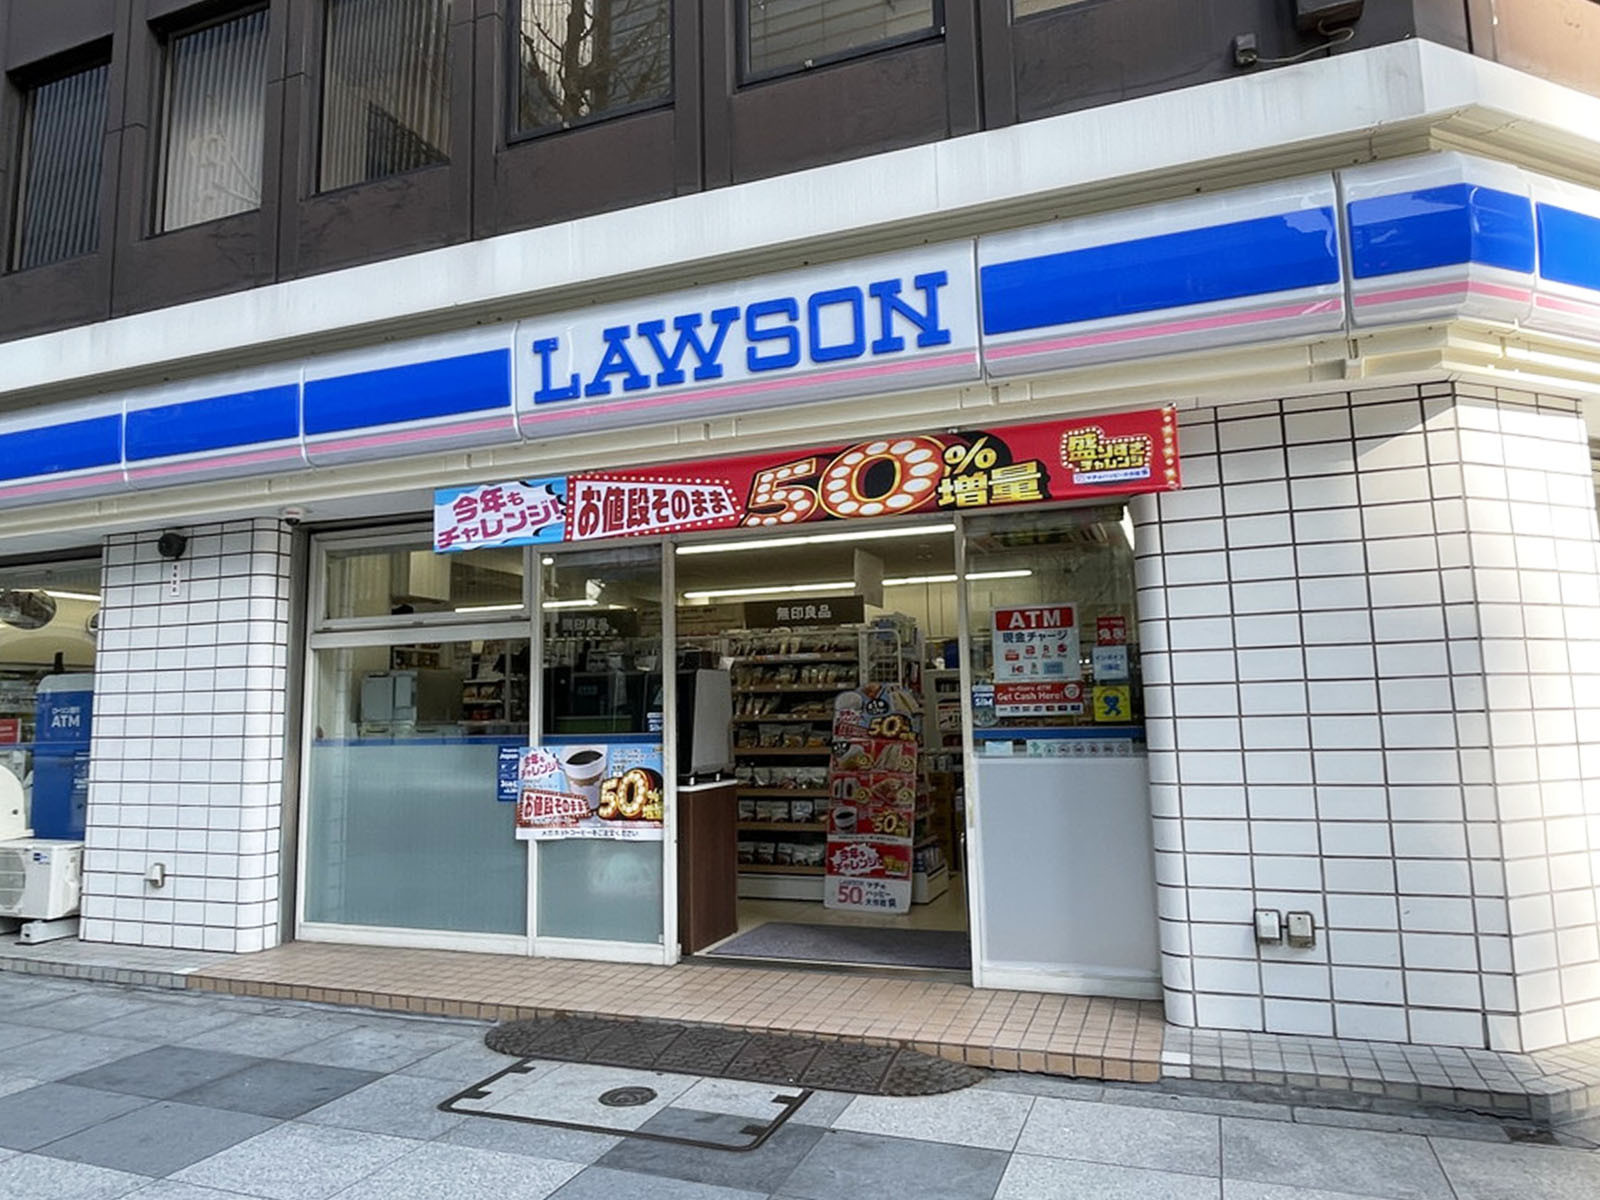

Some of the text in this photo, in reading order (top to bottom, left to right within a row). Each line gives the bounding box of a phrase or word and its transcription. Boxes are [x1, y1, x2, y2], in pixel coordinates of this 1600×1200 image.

[533, 270, 951, 404] LAWSON
[1067, 432, 1146, 462] 盛りすぎ
[1080, 455, 1144, 472] チャレンジ
[937, 461, 1043, 508] 増量
[452, 487, 524, 524] 今年も
[577, 485, 728, 537] お値段そのまま
[776, 604, 832, 621] 無印良品
[1008, 609, 1062, 629] ATM
[1002, 630, 1068, 644] 現金チャージ
[51, 715, 81, 728] ATM
[524, 793, 587, 818] お値段そのまま
